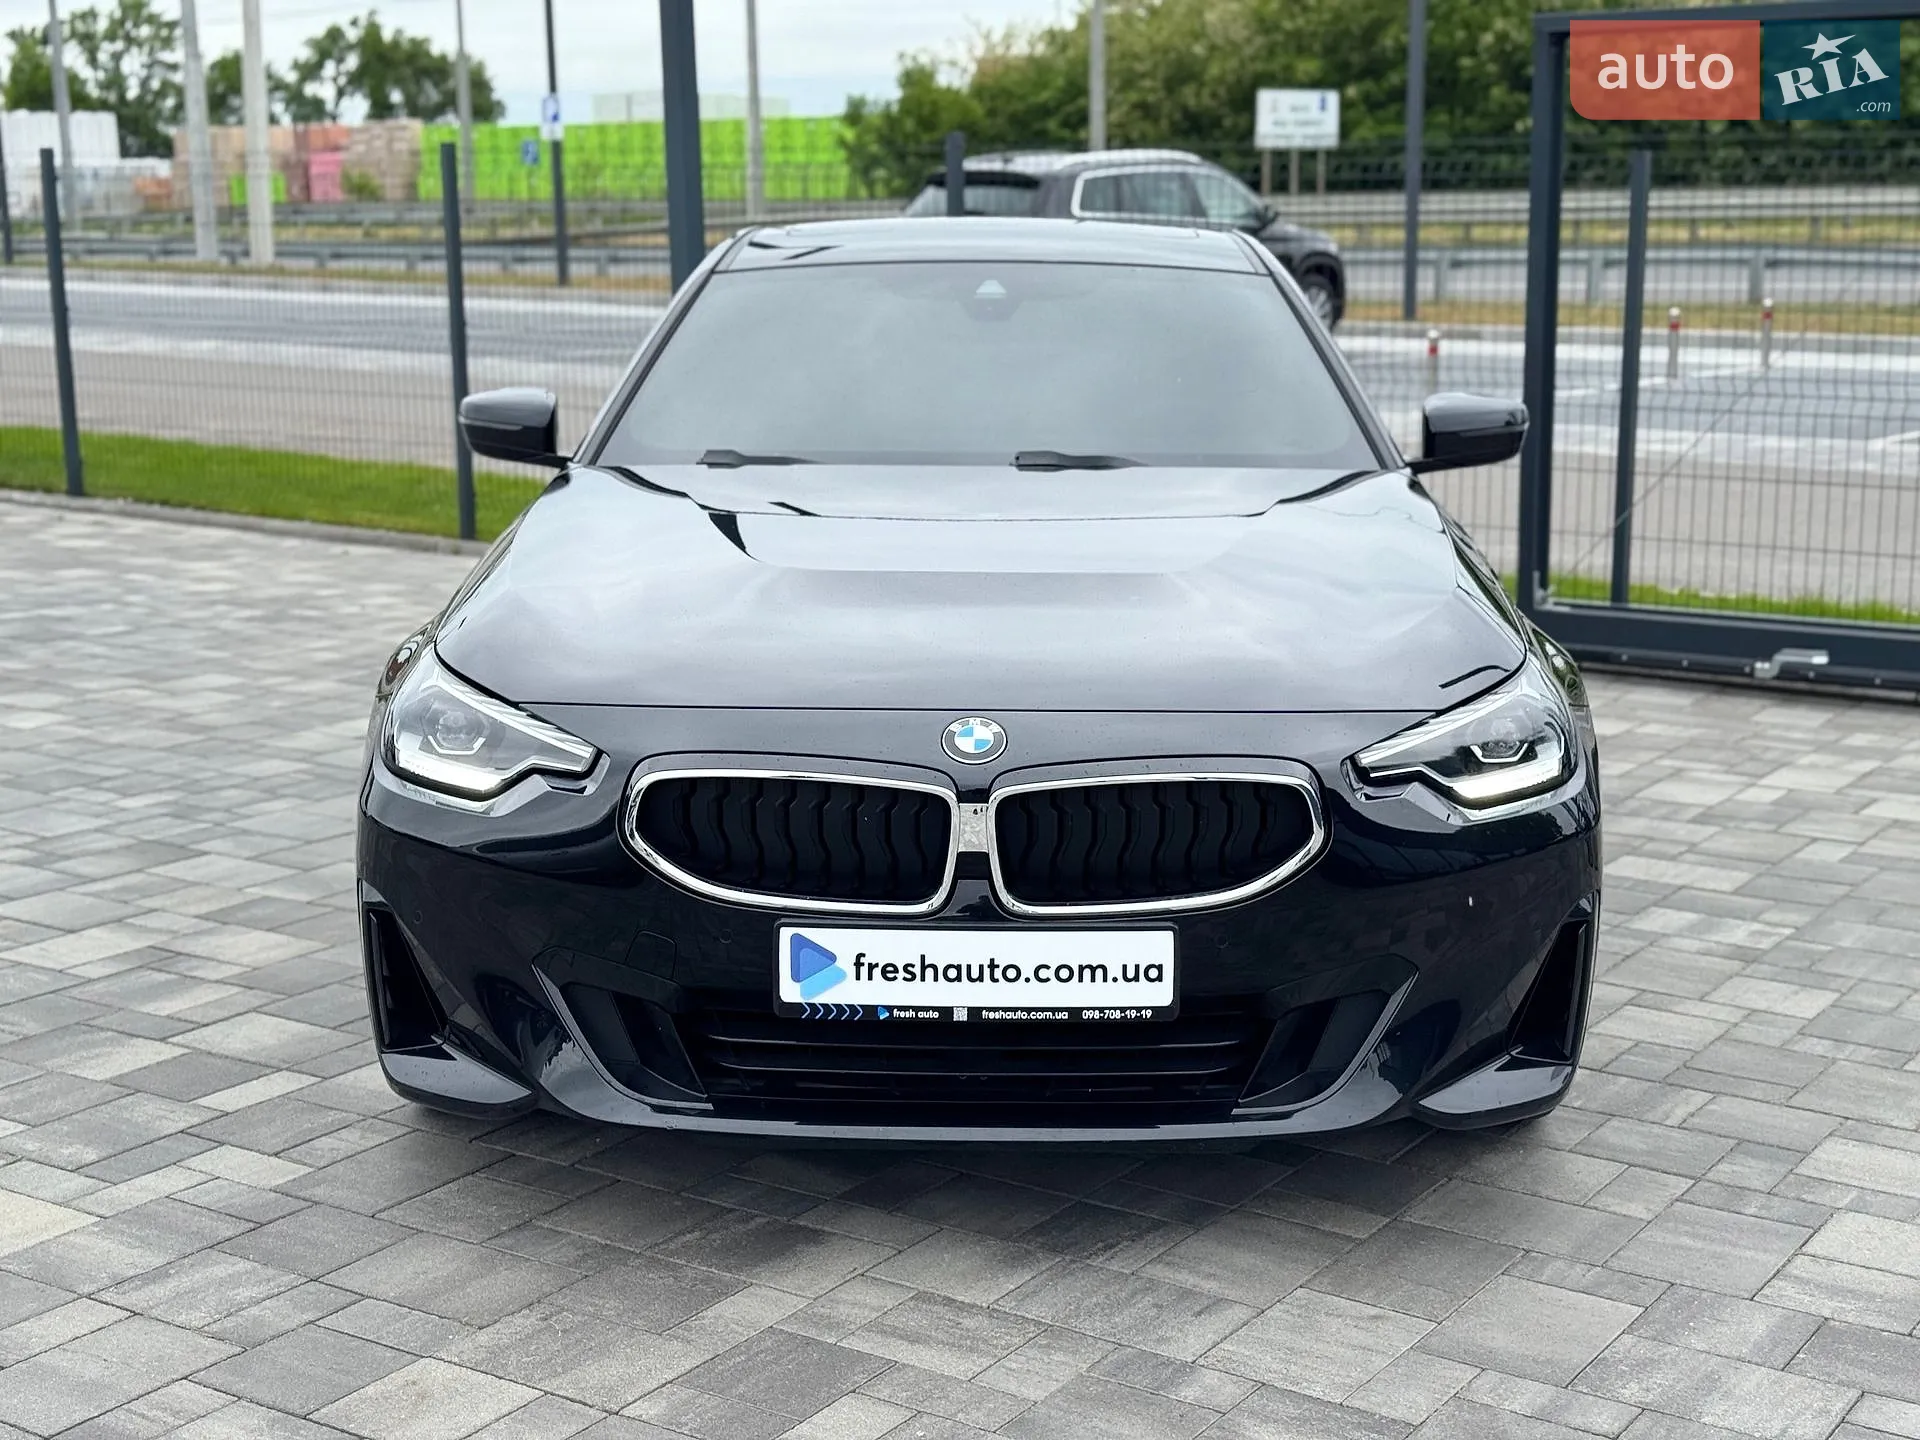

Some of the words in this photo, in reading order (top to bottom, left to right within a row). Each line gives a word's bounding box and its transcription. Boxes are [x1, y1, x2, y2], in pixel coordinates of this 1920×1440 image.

[853, 952, 1164, 984] freshauto.com.ua
[893, 1008, 915, 1019] fresh
[917, 1009, 939, 1019] auto
[981, 1009, 1069, 1021] freshauto.com.ua
[1082, 1009, 1153, 1020] 098-708-19-19
